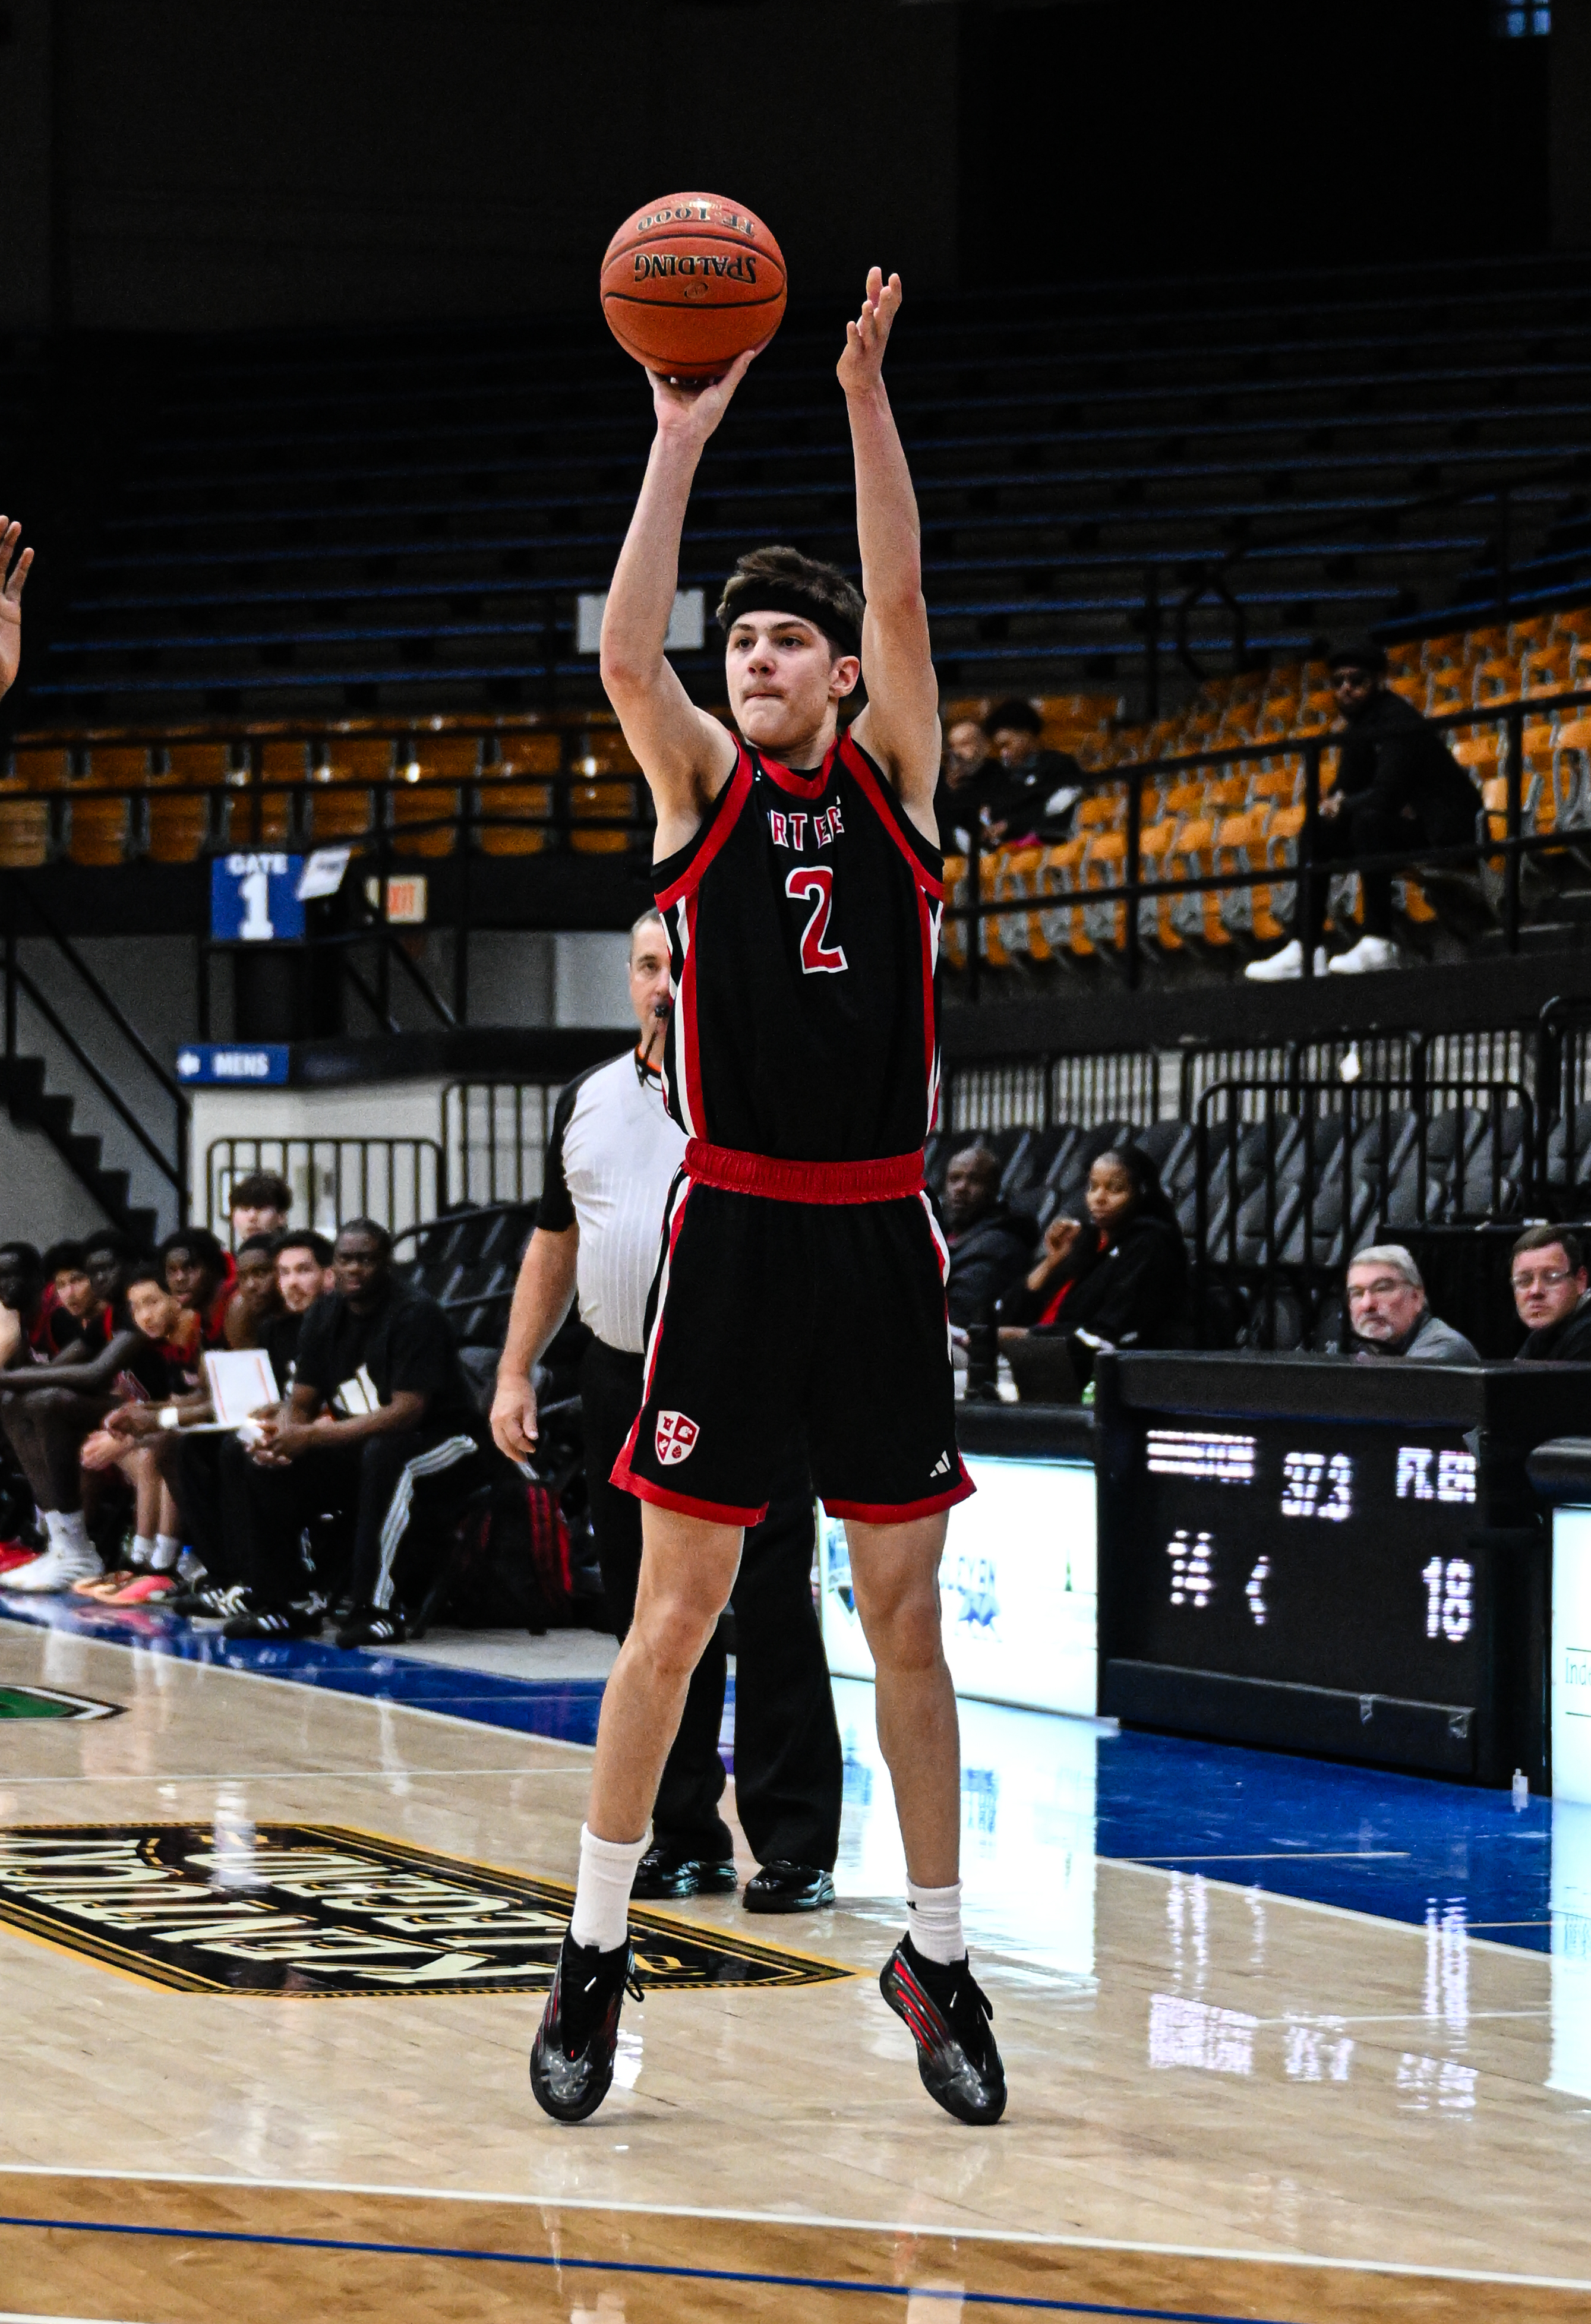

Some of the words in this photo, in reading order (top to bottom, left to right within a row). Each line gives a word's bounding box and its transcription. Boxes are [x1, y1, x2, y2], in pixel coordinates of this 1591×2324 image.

[634, 254, 756, 284] SPALDING
[226, 852, 288, 876] GATE
[767, 809, 808, 851] RT
[240, 872, 274, 940] 1
[785, 866, 848, 974] 2
[0, 1837, 557, 1984] KENTUCKY
[185, 1851, 570, 1947] LEGEND
